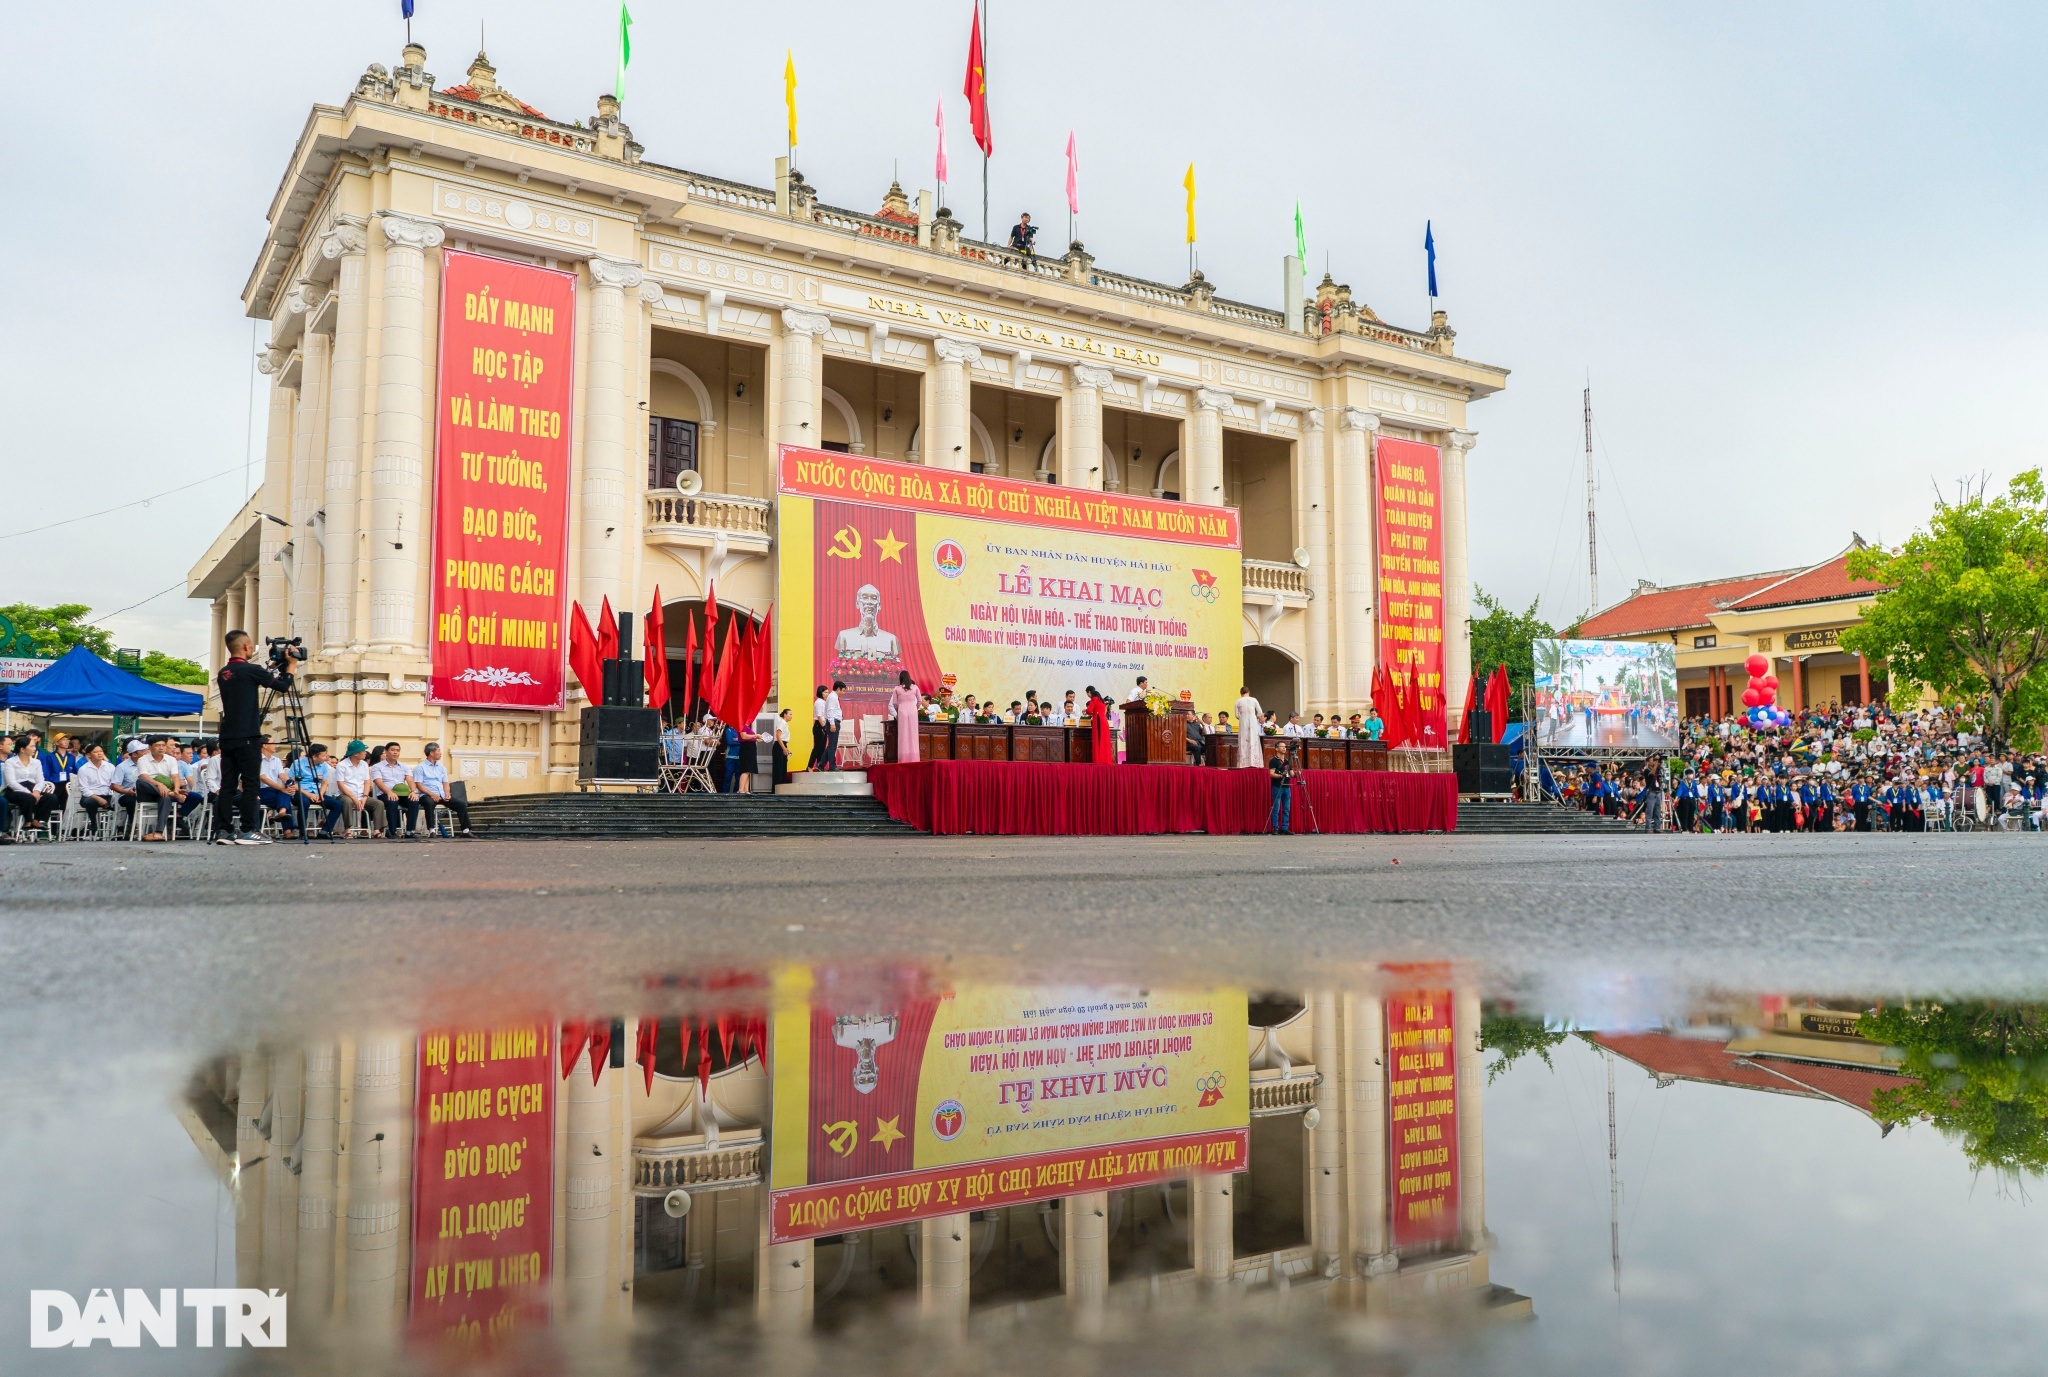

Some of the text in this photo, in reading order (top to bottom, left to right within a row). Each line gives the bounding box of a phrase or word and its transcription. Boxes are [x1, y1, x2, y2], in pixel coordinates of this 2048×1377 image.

[465, 285, 554, 337] ĐẨY MẠNH
[868, 296, 1163, 366] NHÀ VĂN HÓA HẢI HẬU
[472, 347, 544, 388] HỌC TẬP
[451, 393, 561, 440] VÀ LÀM THEO
[461, 449, 548, 493] TƯ TƯỞNG,
[1391, 460, 1427, 486] ĐẢNG BỘ,
[796, 458, 1228, 538] NƯỚC CỘNG HÒA XÃ HỘI CHỦ NGHĨA VIỆT NAM MUÔN NĂM
[1383, 484, 1434, 507] QUÂN VÀ DÂN
[463, 506, 542, 545] ĐẠO ĐỨC,
[1385, 507, 1433, 532] TOÀN HUYỆN
[1390, 531, 1428, 552] PHÁT HUY
[986, 543, 1172, 573] ỦY BAN NHÂN DÂN HUYỆN HẢI HẬU
[1412, 554, 1440, 575] THỐNG
[446, 559, 555, 597] PHONG CÁCH
[998, 564, 1162, 611] LỄ KHAI MẠC
[1408, 580, 1421, 596] ANH
[970, 602, 998, 621] NGÀY
[1002, 604, 1018, 626] HỘI
[1022, 606, 1042, 625] VĂN
[1045, 608, 1065, 627] HÓA
[1074, 608, 1092, 629] THỂ
[1094, 614, 1118, 632] THAO
[1158, 616, 1187, 637] THỐNG
[1389, 598, 1433, 619] QUYẾT TÂM
[438, 605, 558, 649] HỒ CHÍ MINH !
[945, 625, 1208, 660] CHÀO MỪNG KỶ NIỆM 79 NĂM CÁCH MẠNG THÁNG TÁM VÀ QUỐC KHÁNH 2/9
[1381, 621, 1394, 640] XÂY
[1414, 622, 1427, 642] HẢI
[1428, 624, 1442, 646] HẬU
[1800, 631, 1822, 641] BẢO
[1793, 640, 1823, 649] HUYỆN
[1022, 655, 1036, 664] Hải
[1037, 656, 1055, 666] Hậu,
[1056, 659, 1075, 668] ngày
[1085, 660, 1106, 670] tháng
[1112, 662, 1128, 670] năm
[1129, 663, 1145, 671] 2024
